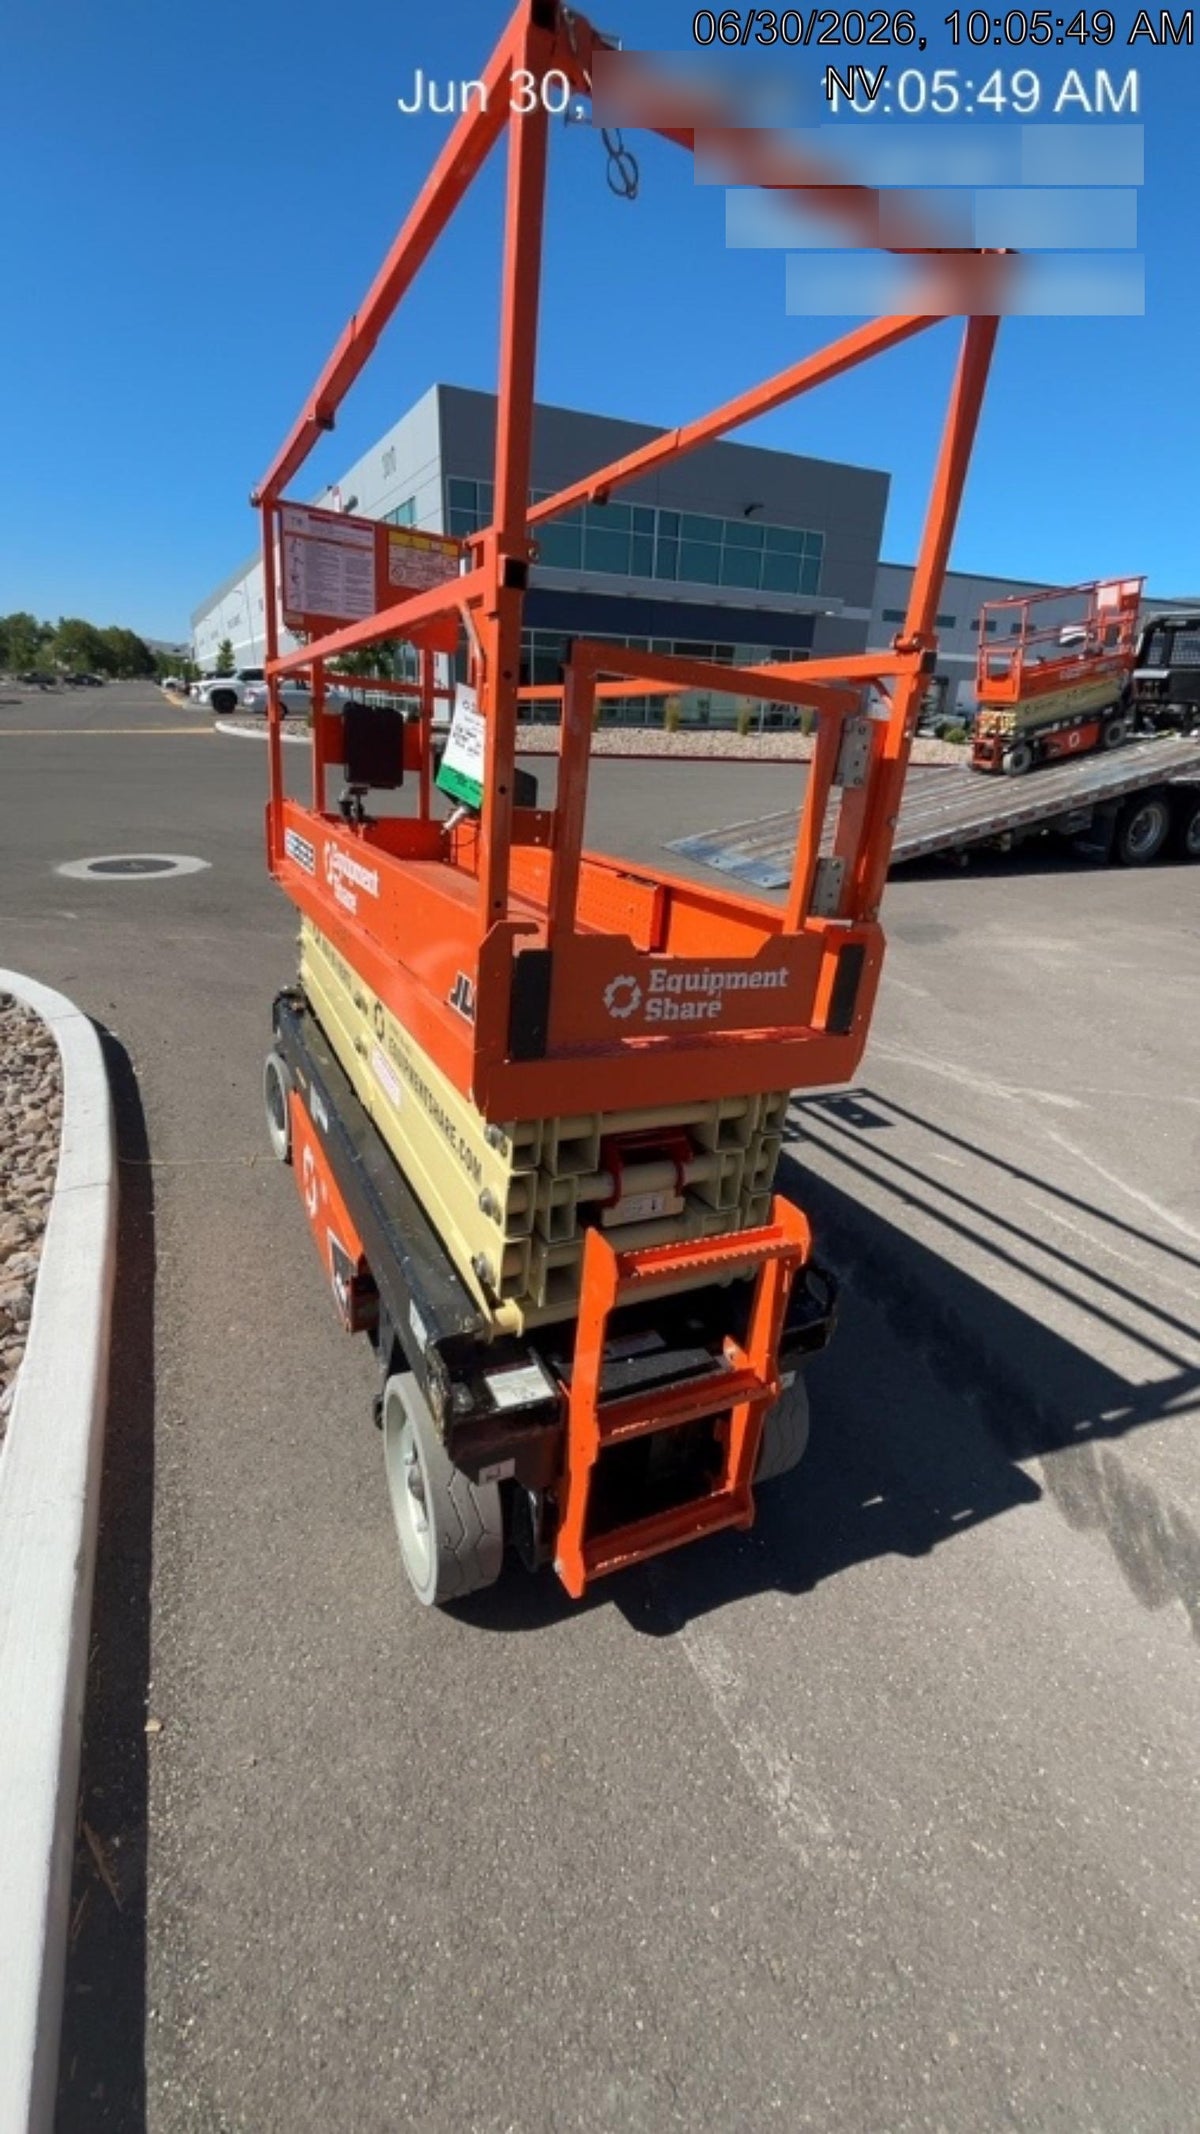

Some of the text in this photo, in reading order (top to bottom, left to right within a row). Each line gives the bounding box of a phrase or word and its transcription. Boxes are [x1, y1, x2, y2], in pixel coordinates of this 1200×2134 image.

[648, 967, 789, 996] Equipment
[450, 970, 475, 1026] JL
[644, 999, 722, 1022] Share
